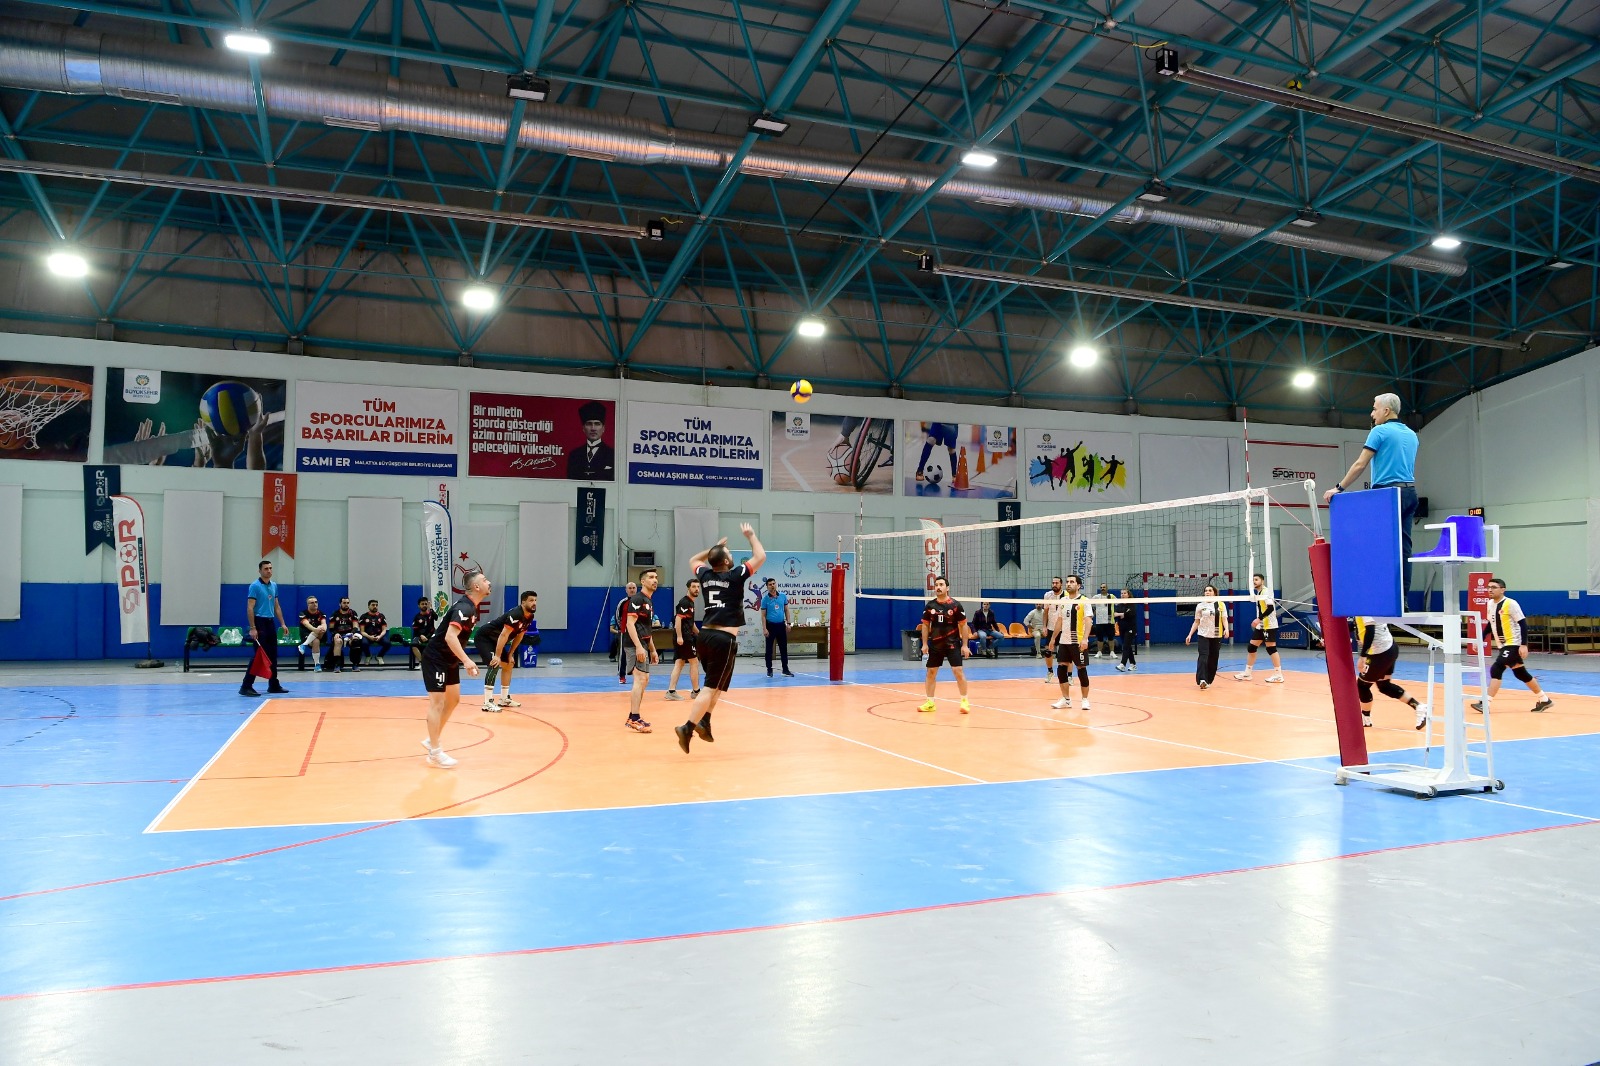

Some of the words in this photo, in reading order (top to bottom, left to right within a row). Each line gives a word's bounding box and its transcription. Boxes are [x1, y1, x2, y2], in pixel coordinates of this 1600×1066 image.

[363, 398, 396, 413] TÜM
[473, 405, 486, 416] Bir
[488, 405, 523, 418] milletin
[310, 412, 446, 430] SPORCULARIMIZA
[472, 418, 506, 430] sporda
[507, 420, 553, 433] gösterdiği
[684, 417, 712, 431] TÜM
[301, 427, 391, 443] BAŞARILAR
[394, 430, 453, 445] DİLERİM
[472, 430, 495, 440] azim
[497, 432, 502, 441] o
[504, 430, 539, 443] milletin
[639, 429, 753, 447] SPORCULARIMIZA
[472, 441, 520, 454] geleceğini
[521, 443, 565, 456] yükseltir.
[633, 443, 707, 457] BAŞARILAR
[709, 446, 760, 460] DİLERİM
[335, 457, 350, 467] ER
[637, 470, 665, 478] OSMAN
[666, 472, 688, 480] AŞKIN
[118, 518, 140, 615] SPOR
[708, 590, 722, 607] 5
[1079, 652, 1085, 661] 6
[1502, 650, 1510, 658] 5
[435, 672, 446, 683] 41
